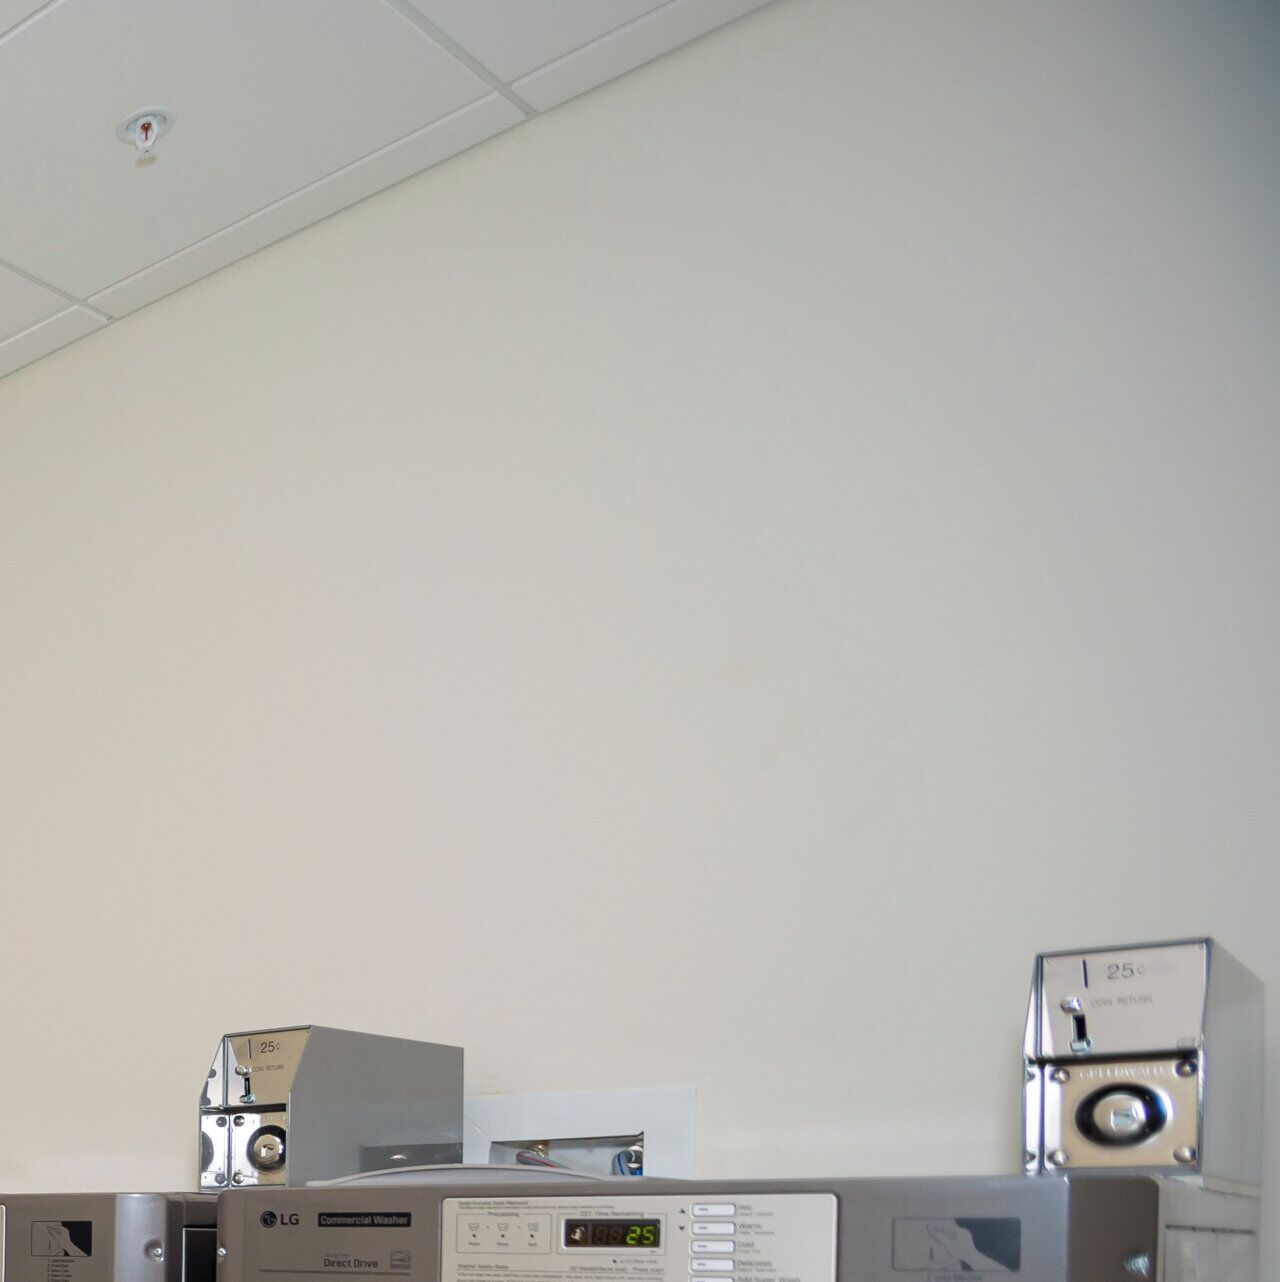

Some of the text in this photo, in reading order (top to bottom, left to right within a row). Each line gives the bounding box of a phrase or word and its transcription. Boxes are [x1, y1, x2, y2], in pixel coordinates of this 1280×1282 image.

[1090, 995, 1153, 1008] COIN RETURN
[280, 1213, 300, 1226] LG
[320, 1215, 409, 1225] Commercial Washer
[626, 1225, 655, 1244] 25
[323, 1258, 378, 1268] Direct Drive
